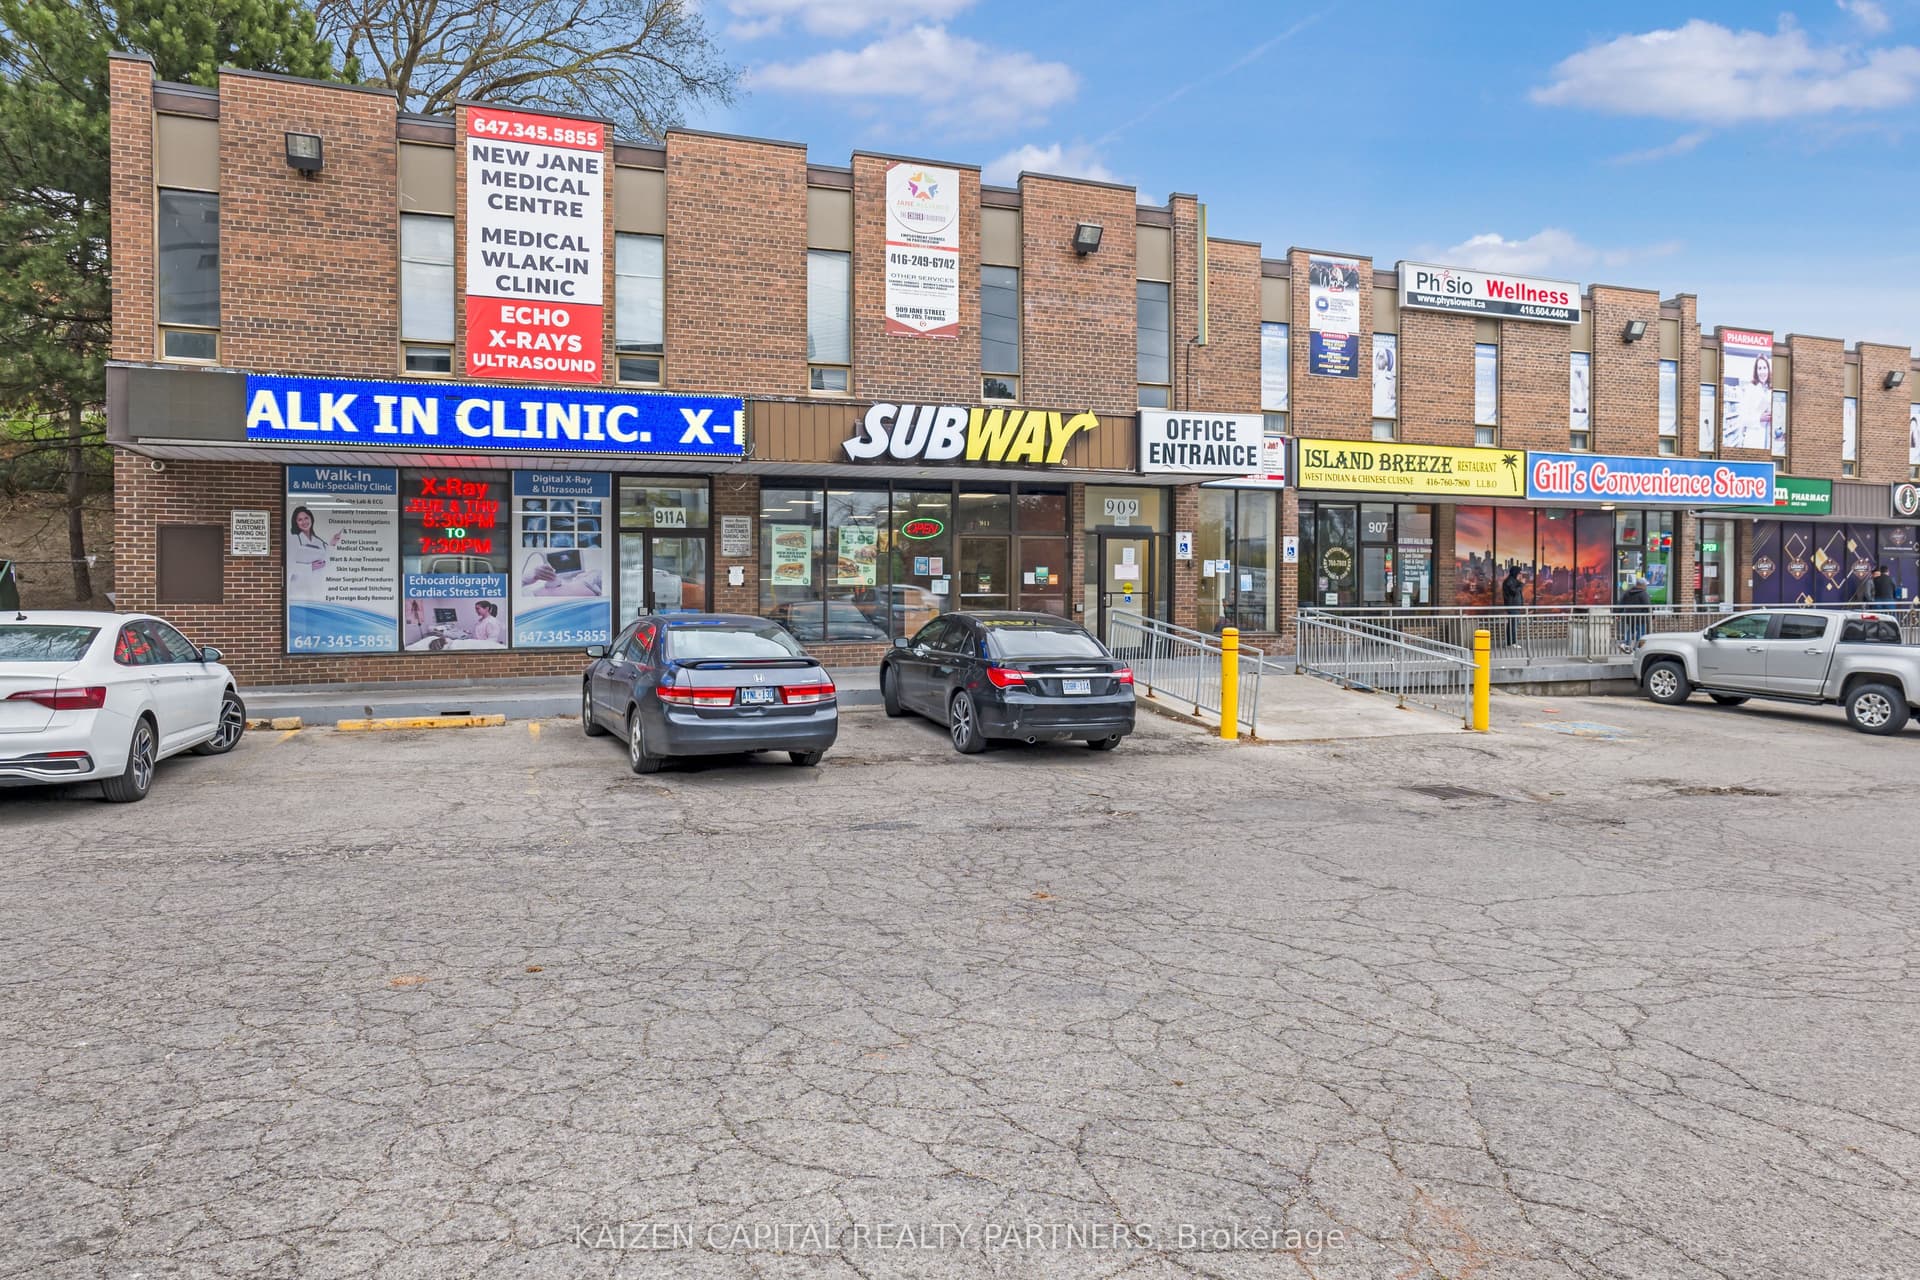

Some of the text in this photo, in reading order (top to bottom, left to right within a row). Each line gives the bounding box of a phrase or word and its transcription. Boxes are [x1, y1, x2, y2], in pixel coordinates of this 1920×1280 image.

[473, 118, 598, 146] 647.345.5855
[472, 145, 599, 174] NEW JANE
[481, 169, 590, 196] MEDICAL
[487, 193, 583, 218] CENTRE
[481, 227, 590, 252] MEDICAL
[481, 250, 589, 275] WLAK-IN
[890, 252, 955, 270] 416-249-6742
[495, 274, 575, 297] CLINIC
[890, 272, 955, 284] OTHER SERVICES
[1486, 279, 1569, 305] Wellness
[1417, 294, 1486, 309] www.physiowell.ca
[500, 305, 570, 328] ECHO
[909, 307, 923, 315] JANE
[924, 308, 945, 316] STREET
[488, 329, 583, 353] X-RAYS
[1727, 333, 1769, 346] PHARMACY
[472, 352, 597, 373] ULTRASOUND
[246, 389, 358, 432] ALK
[372, 395, 439, 436] IN
[454, 398, 652, 443] CLINIC.
[842, 402, 1099, 465] SUBWAY
[1166, 418, 1237, 442] OFFICE
[1149, 442, 1257, 466] ENTRANCE
[1304, 448, 1374, 470] ISLAND
[1379, 453, 1453, 474] BREEZE
[1457, 460, 1497, 473] RESTAURANT
[315, 468, 372, 482] Walk-In
[532, 475, 592, 486] Digital X-Ray
[1304, 471, 1323, 482] WEST
[1325, 473, 1350, 483] INDIAN
[1351, 474, 1357, 483] &
[1358, 475, 1387, 484] CHINESE
[1387, 476, 1414, 485] CUISINE
[1425, 478, 1471, 488] 416-760-7800
[1534, 460, 1767, 498] Gill's Convenience Store
[292, 481, 393, 492] & Multi-Speciality Clinic
[421, 476, 489, 500] X-Ray
[532, 486, 593, 495] & Ultrasound
[464, 500, 499, 513] THU
[1791, 493, 1830, 503] PHARMACY
[1106, 500, 1137, 515] 909
[655, 510, 685, 524] 911A
[445, 527, 466, 538] TO
[907, 522, 939, 535] OPEN
[1368, 522, 1389, 533] 907
[418, 537, 492, 554] 7:30PM
[409, 575, 500, 587] Echocardiography
[409, 587, 502, 597] Cardiac Stress Test
[294, 635, 393, 649] 647-345-5855
[518, 629, 607, 643] 647-345-5855
